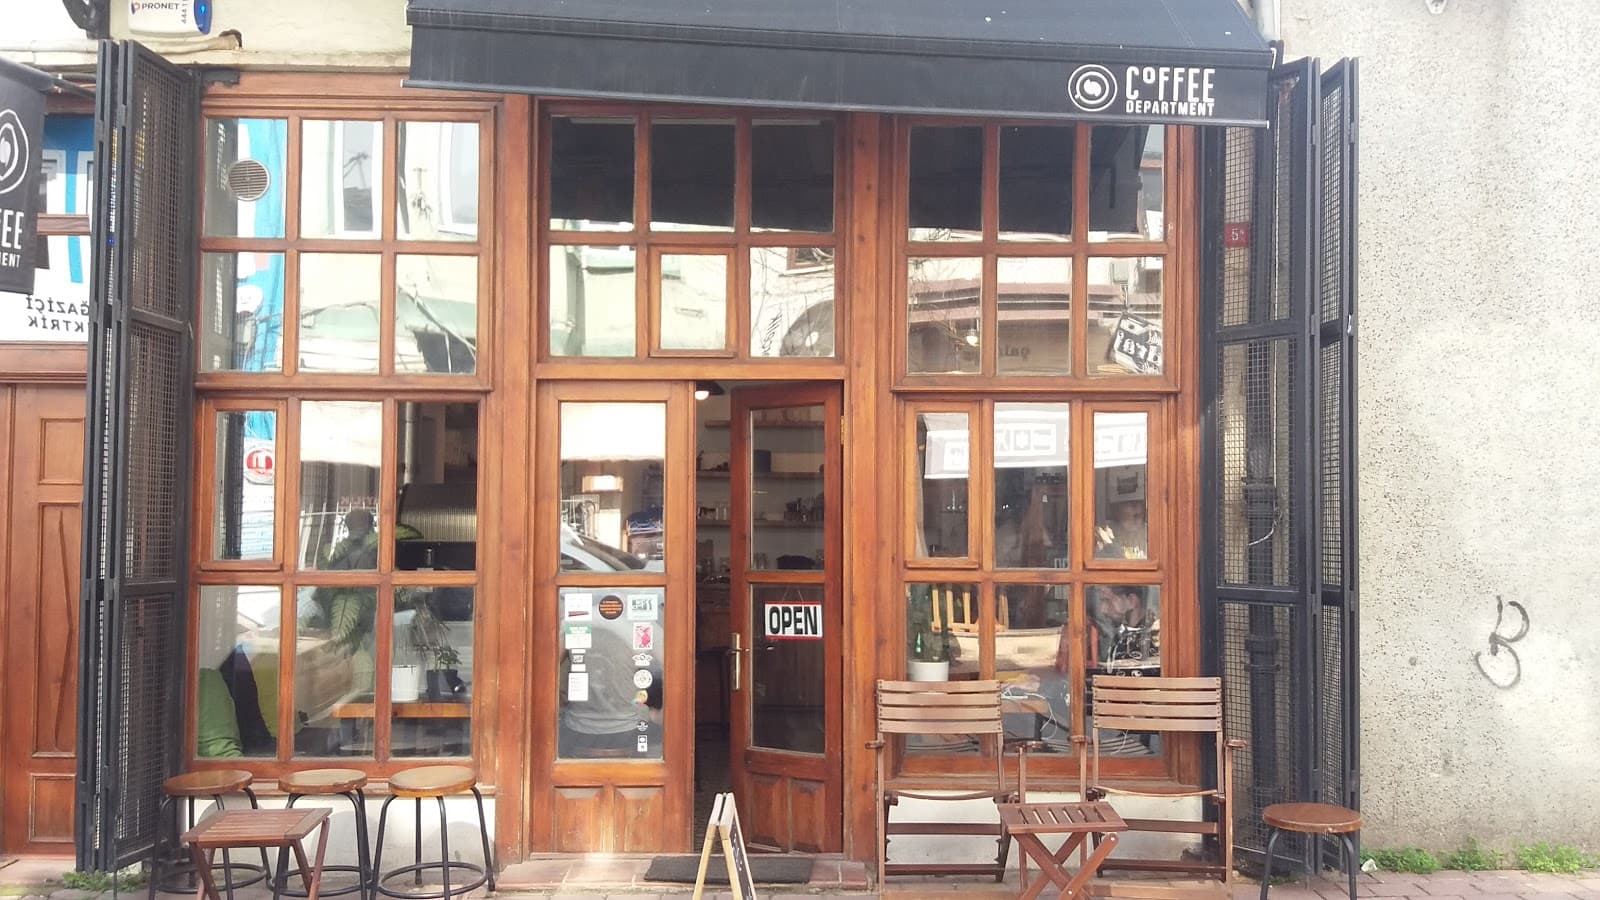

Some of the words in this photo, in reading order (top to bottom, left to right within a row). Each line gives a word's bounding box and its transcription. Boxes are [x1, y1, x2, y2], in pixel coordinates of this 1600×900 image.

[141, 2, 179, 10] PRONET
[1126, 101, 1215, 116] DEPARTMENT
[0, 208, 24, 249] EE
[0, 251, 21, 268] ENT
[769, 606, 818, 635] OPEN
